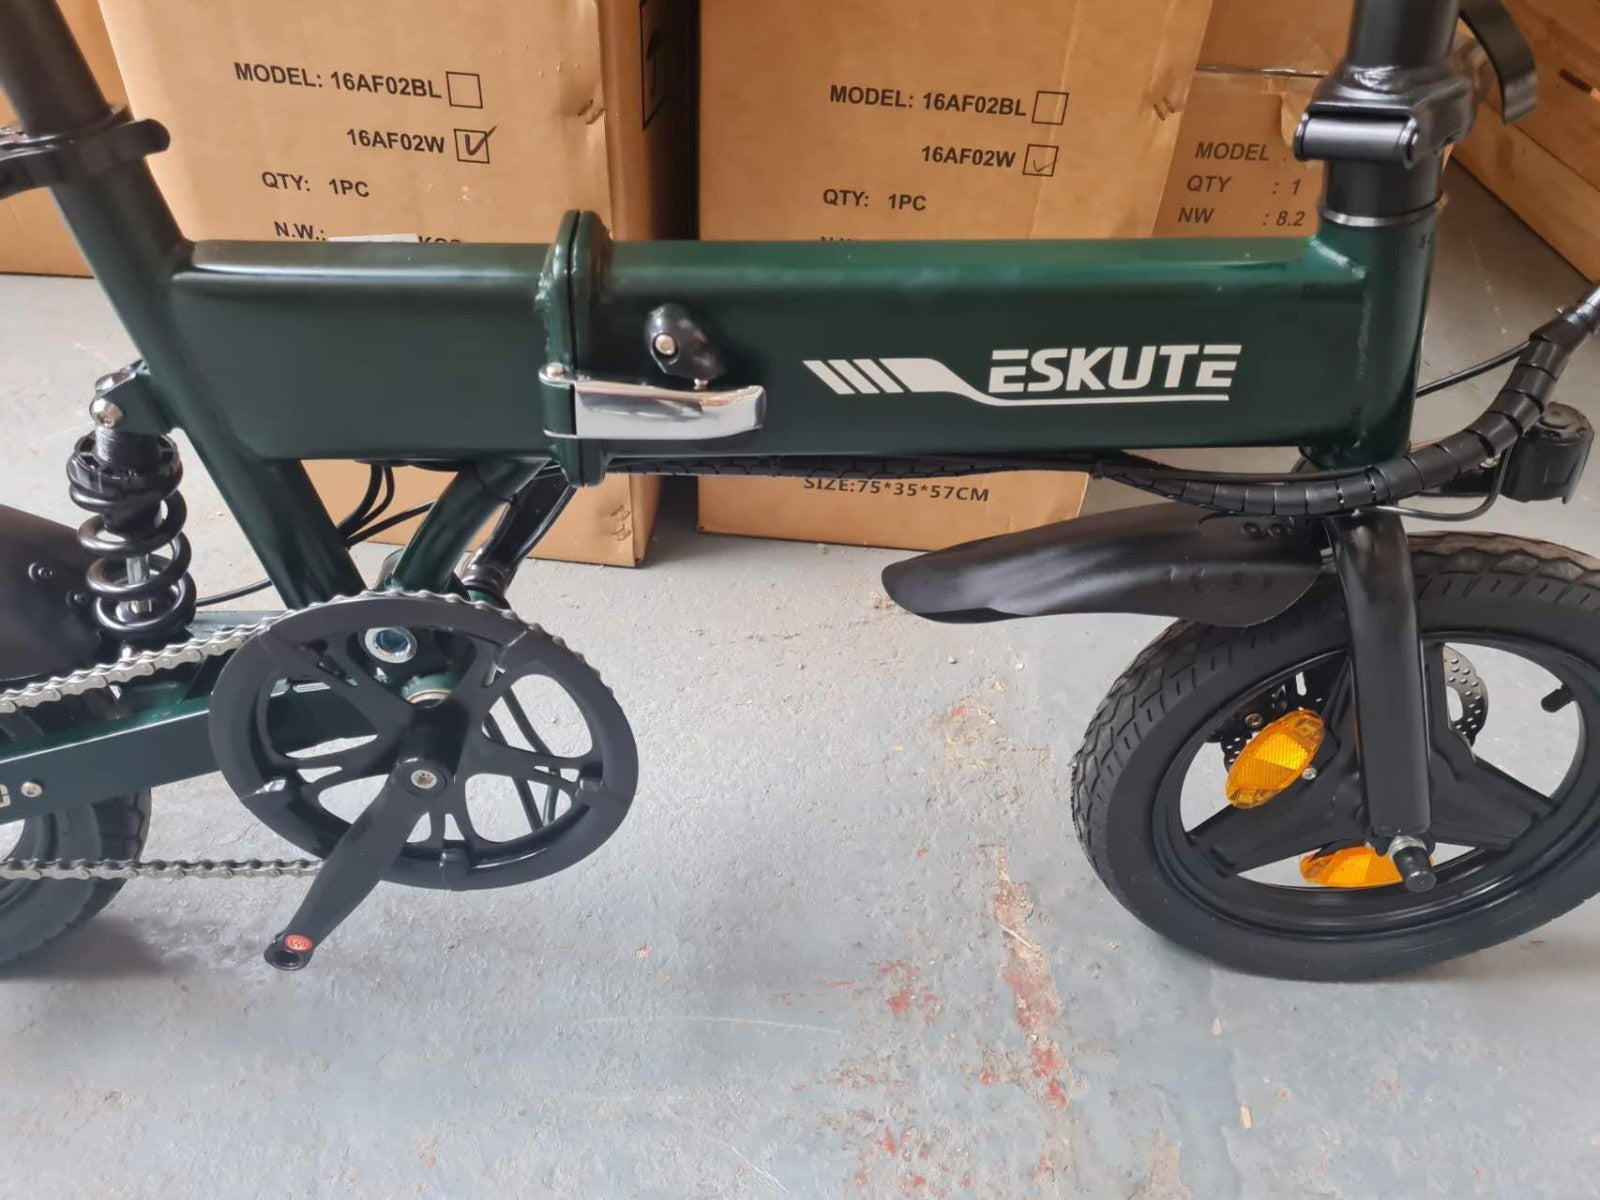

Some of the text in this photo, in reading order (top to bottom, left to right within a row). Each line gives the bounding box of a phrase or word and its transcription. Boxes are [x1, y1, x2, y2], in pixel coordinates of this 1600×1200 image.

[234, 62, 442, 99] MODEL: 16AF02BL
[830, 85, 1028, 117] MODEL: 16AF02BL
[347, 128, 445, 154] 16AF02W
[1195, 141, 1270, 162] MODEL
[922, 145, 1017, 169] 16AF02W
[261, 171, 370, 198] QTY: 1PC
[1187, 175, 1232, 193] QTY
[823, 188, 927, 212] QTY: 1PC
[1178, 207, 1214, 224] NW
[274, 221, 326, 242] N.W.:
[988, 344, 1243, 394] ESKUTE
